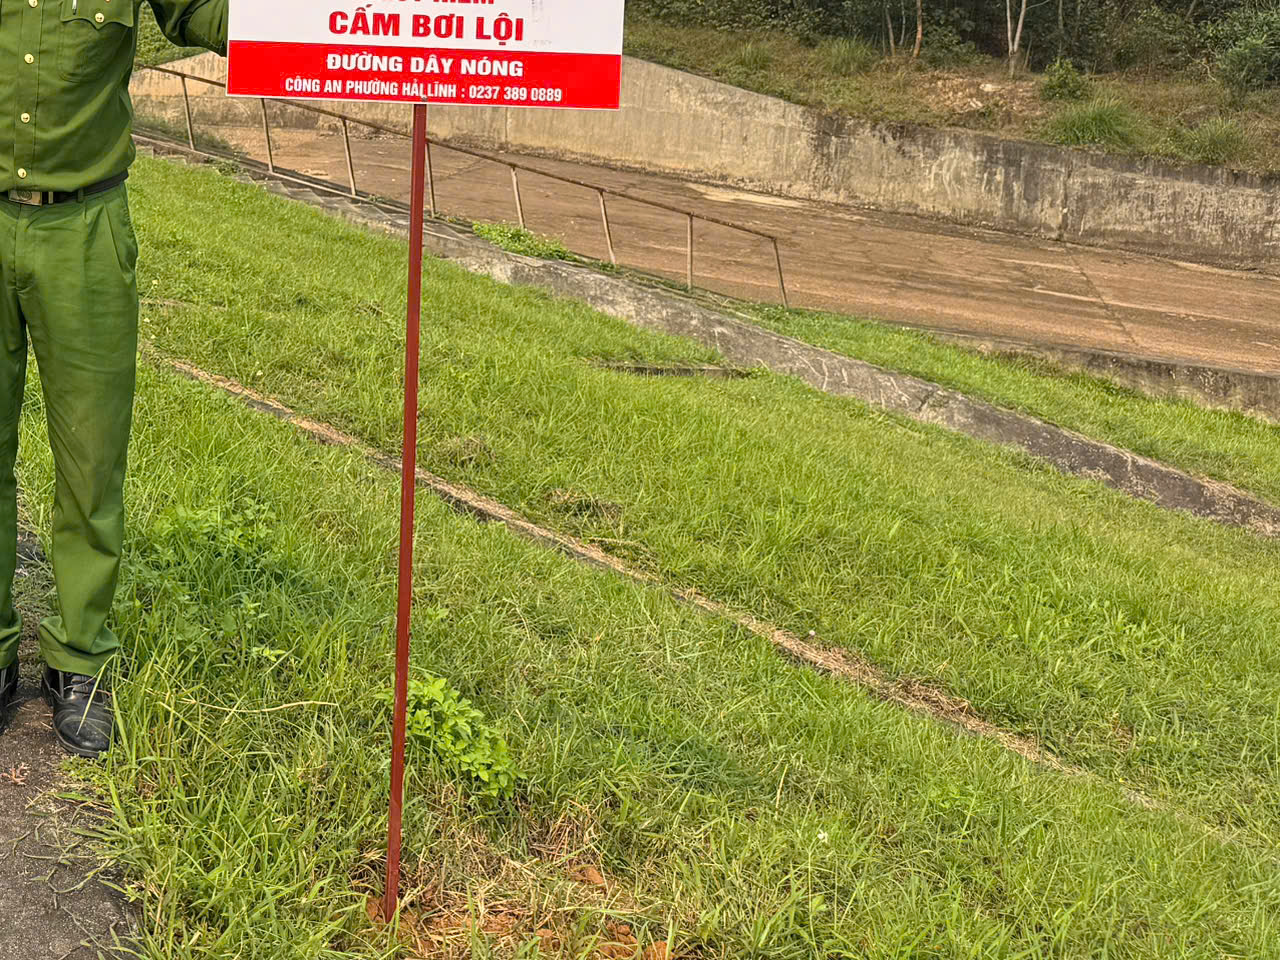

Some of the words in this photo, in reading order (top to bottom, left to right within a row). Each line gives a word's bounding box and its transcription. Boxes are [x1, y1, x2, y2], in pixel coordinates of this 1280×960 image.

[328, 3, 401, 37] CẤM
[411, 13, 465, 39] BƠI
[475, 12, 524, 46] LỘI
[326, 51, 403, 73] ĐƯỜNG
[410, 54, 454, 75] DÂY
[460, 56, 524, 78] NÓNG
[285, 75, 320, 93] CÔNG
[323, 79, 342, 94] AN
[345, 78, 399, 96] PHƯỜNG
[427, 81, 457, 99] LĨNH
[468, 85, 500, 100] 0237
[503, 87, 528, 101] 389
[530, 88, 562, 102] 0889
